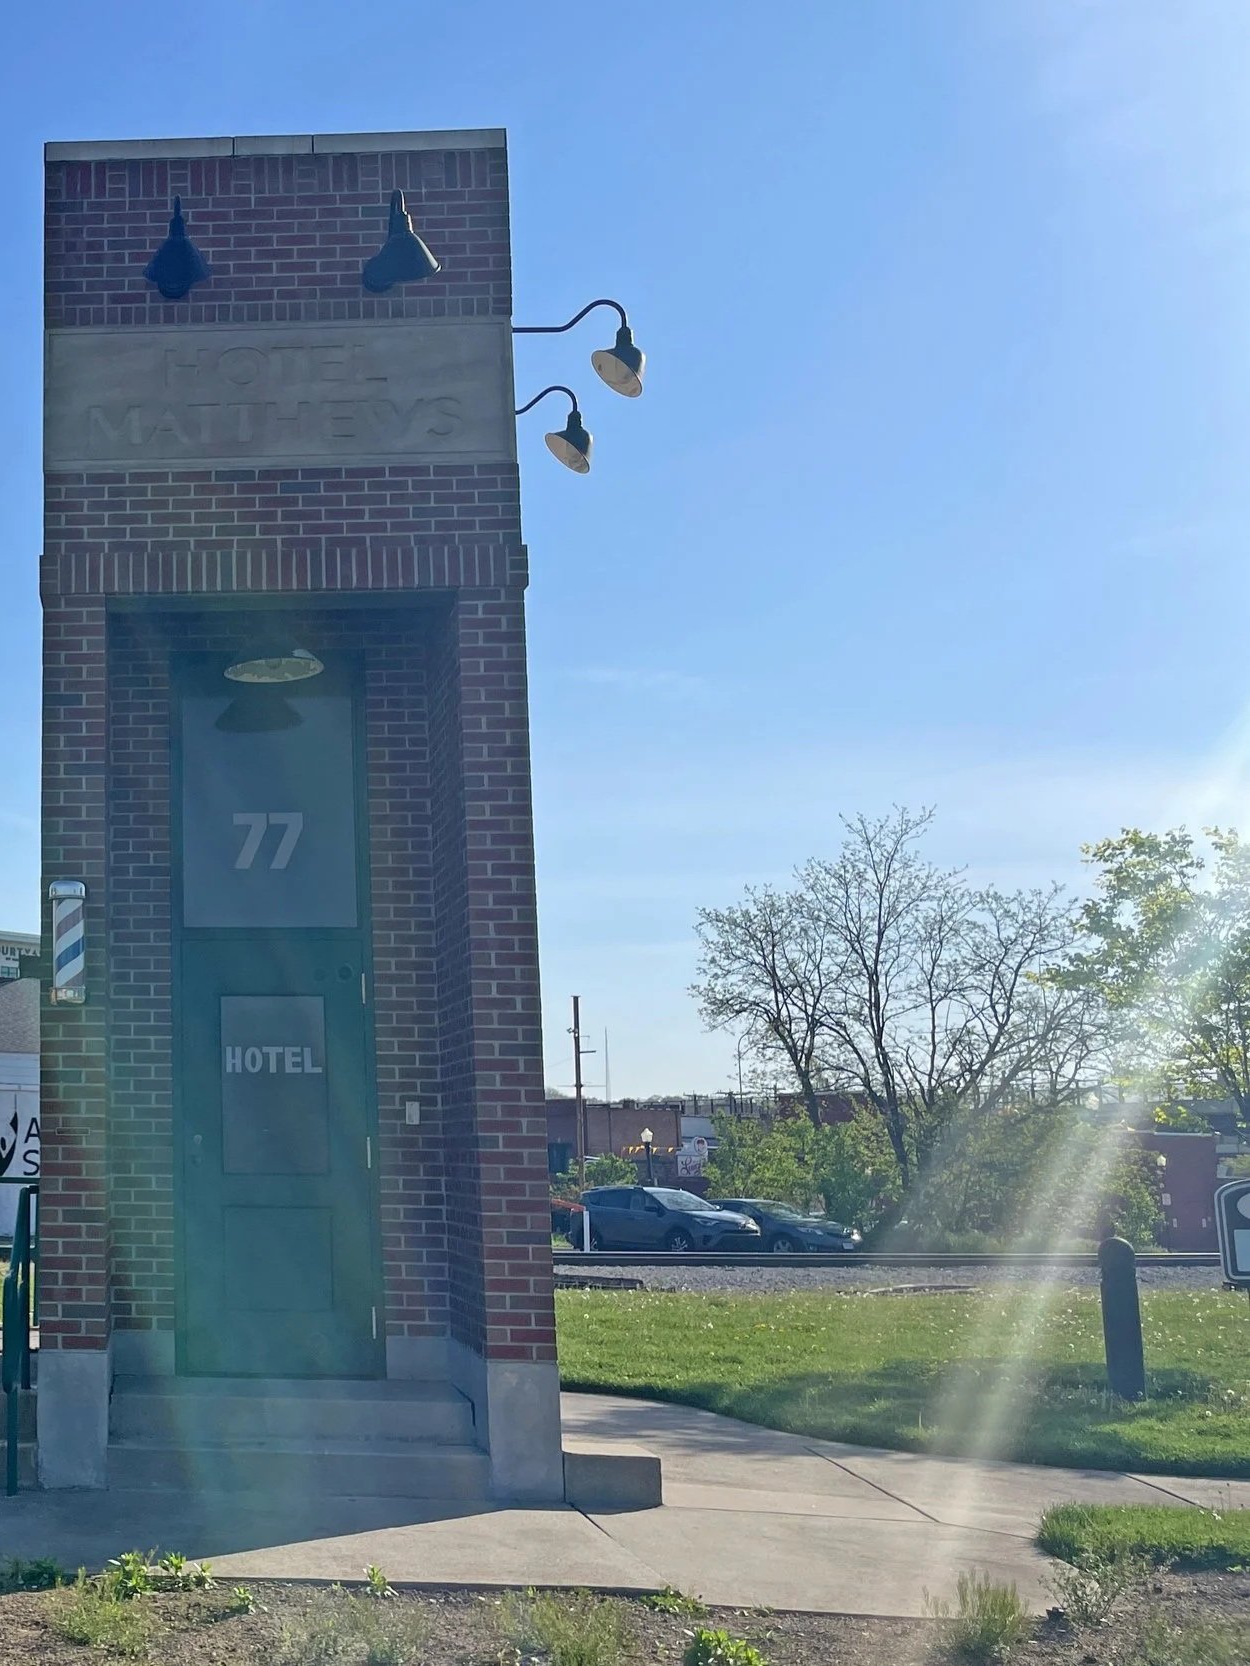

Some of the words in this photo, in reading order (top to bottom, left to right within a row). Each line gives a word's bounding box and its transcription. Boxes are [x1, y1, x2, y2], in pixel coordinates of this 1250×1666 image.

[163, 344, 388, 389] HOTEL
[86, 396, 463, 447] MATTHEWS
[232, 811, 304, 870] 77
[225, 1046, 323, 1074] HOTEL
